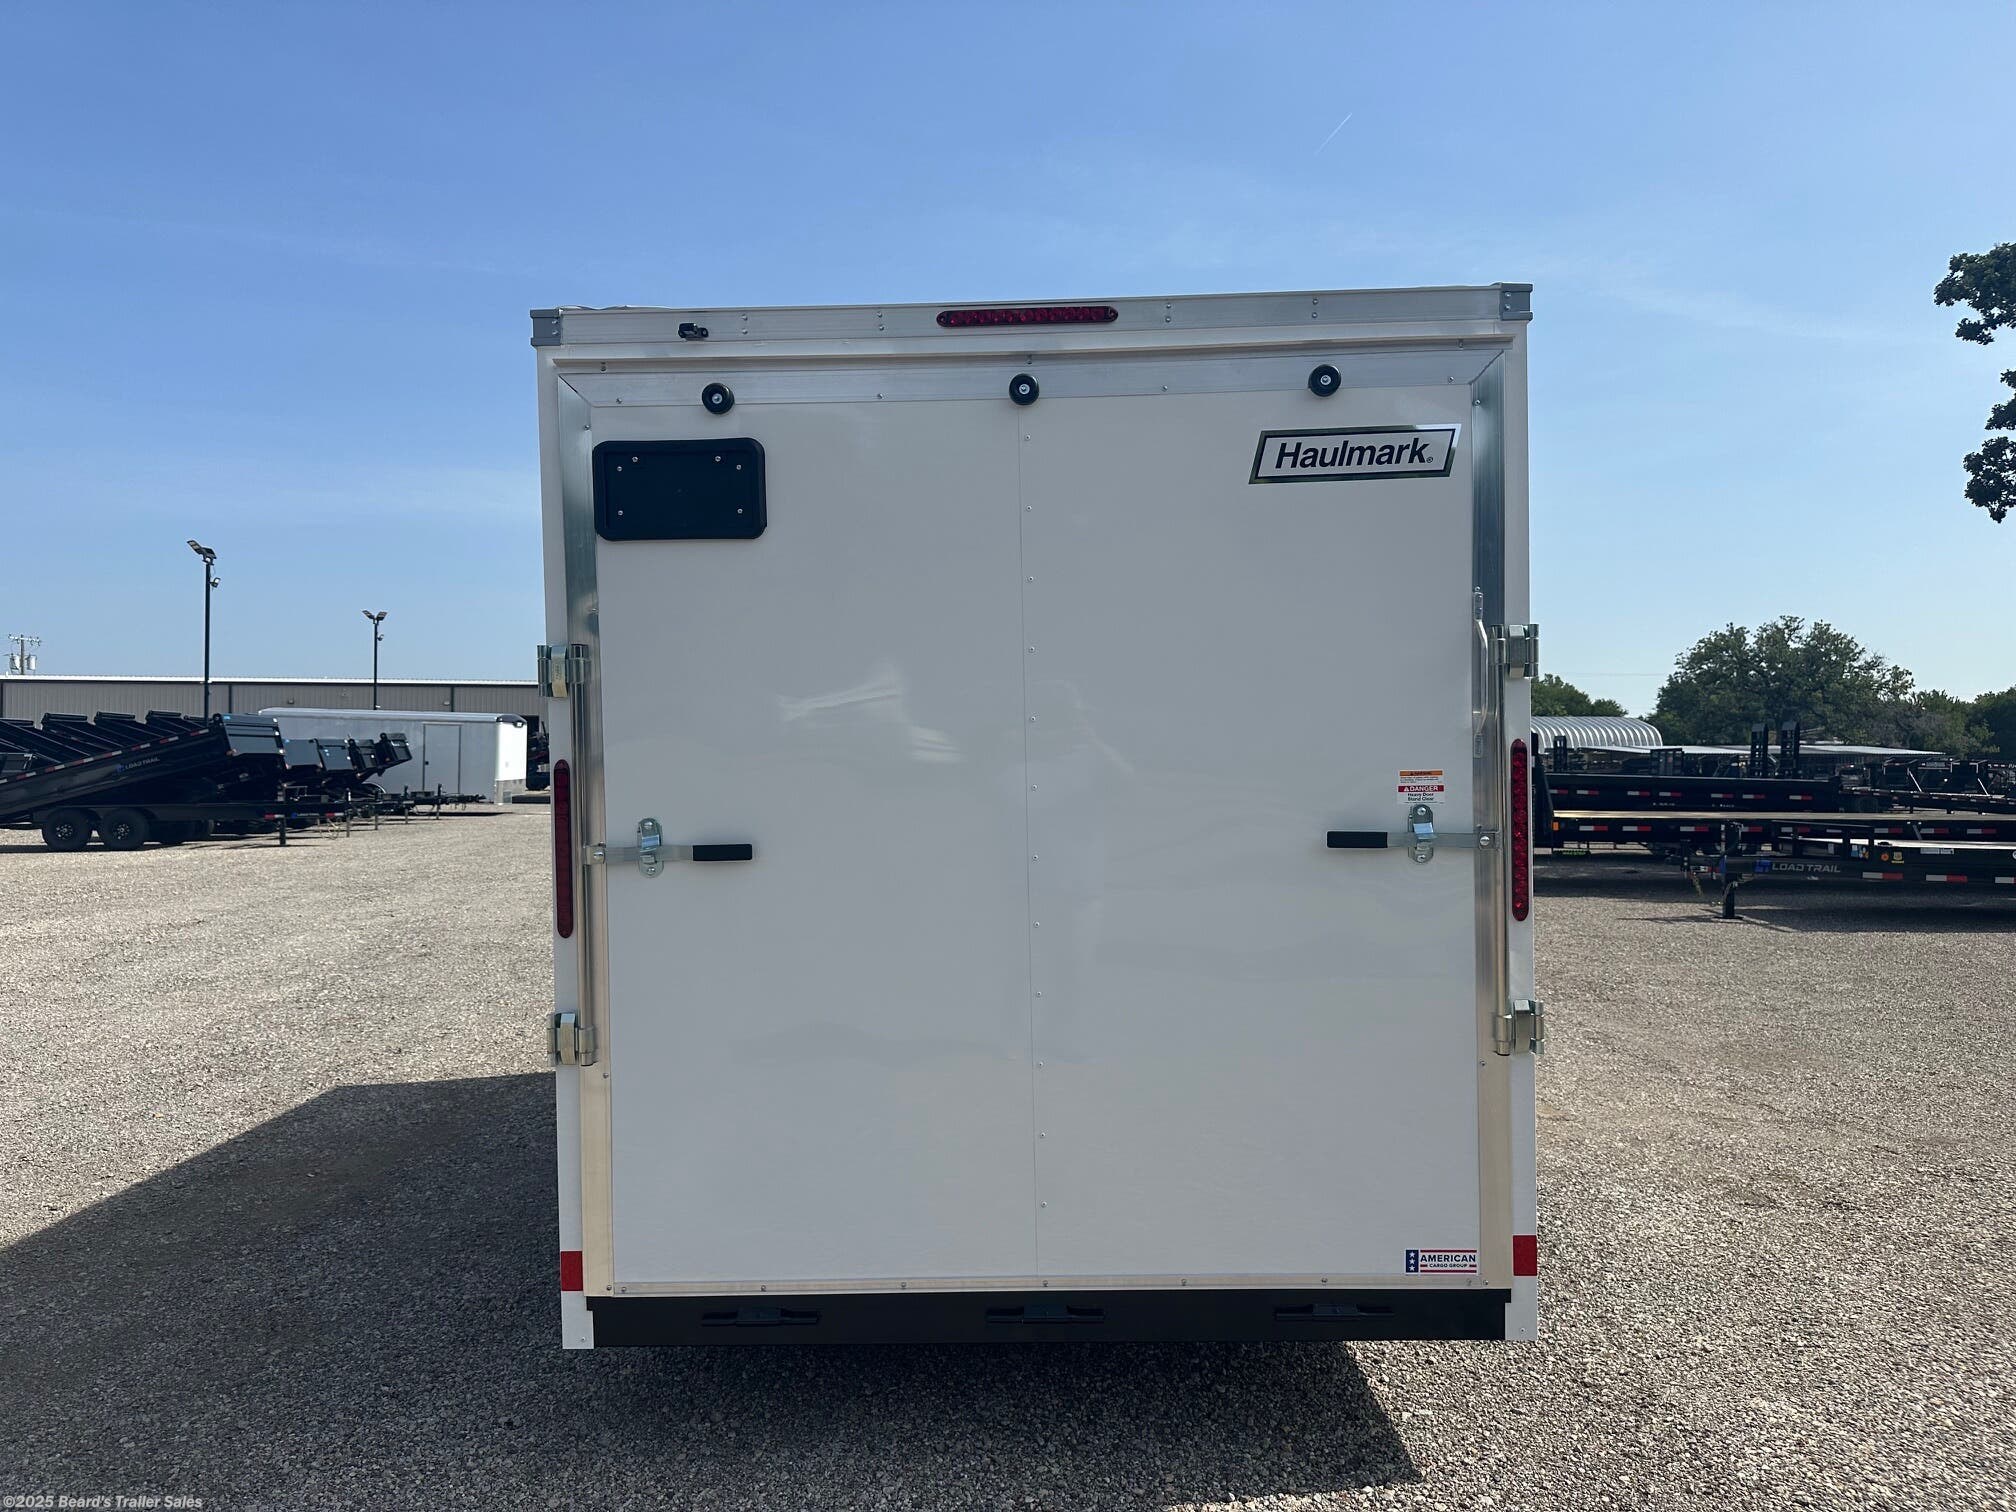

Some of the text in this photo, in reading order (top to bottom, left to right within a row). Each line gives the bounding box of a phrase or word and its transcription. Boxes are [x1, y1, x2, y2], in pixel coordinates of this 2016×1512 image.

[1772, 863, 1841, 873] LOAD TRAIL
[1420, 1254, 1476, 1262] AMERICAN
